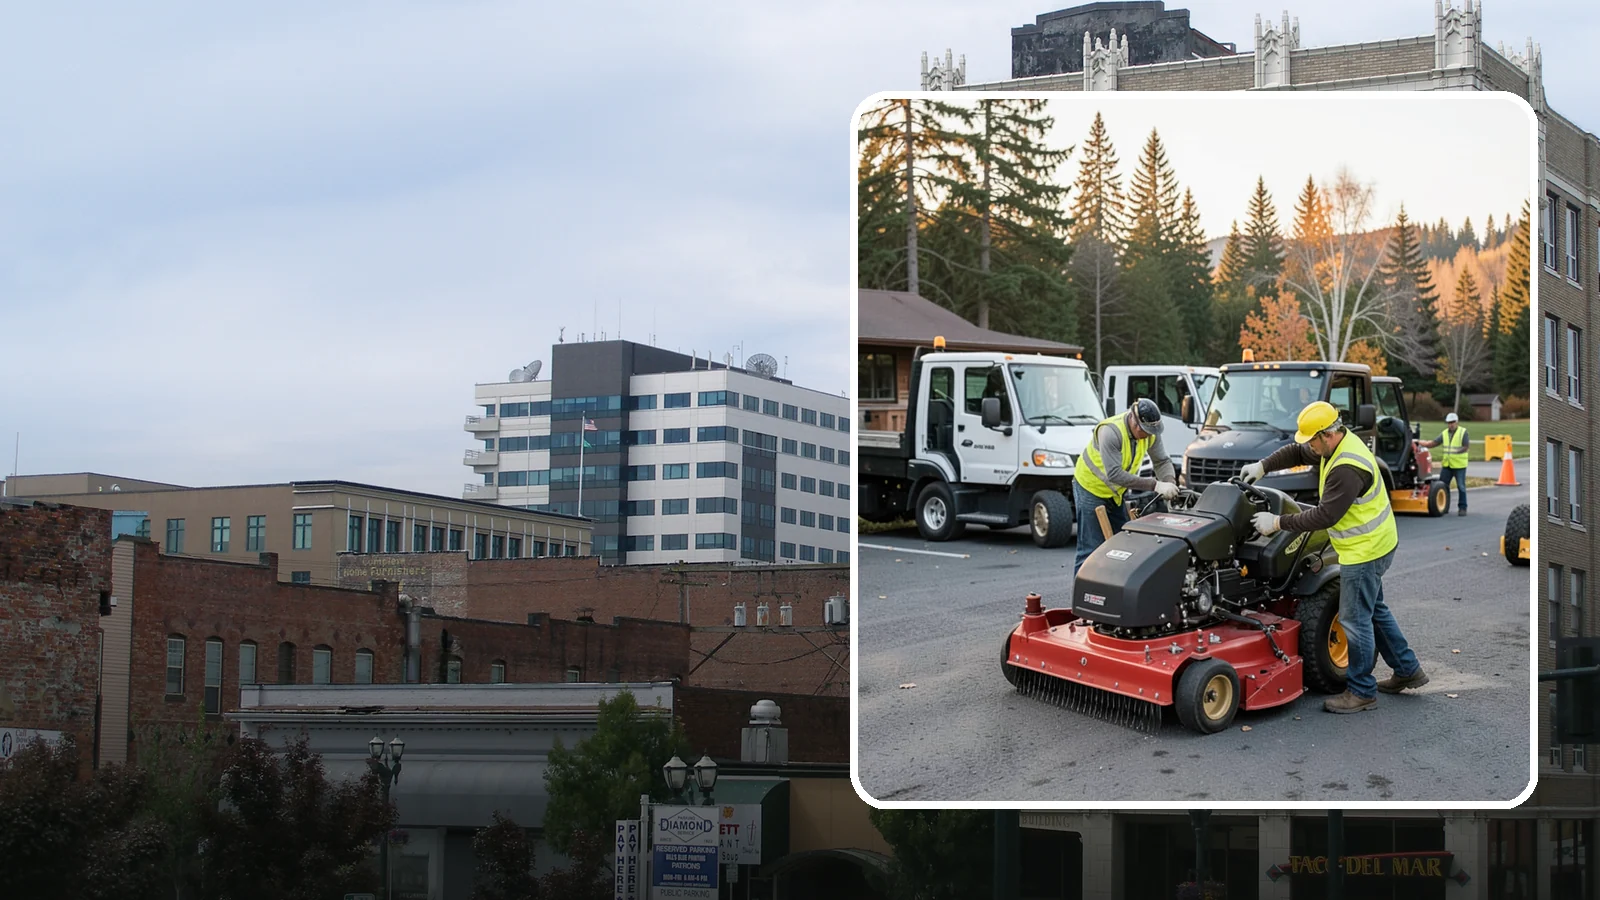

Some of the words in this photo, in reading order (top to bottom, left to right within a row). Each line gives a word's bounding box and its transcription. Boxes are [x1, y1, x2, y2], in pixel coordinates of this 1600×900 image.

[370, 566, 427, 576] Furnishers
[660, 818, 713, 833] DIAMOND
[1022, 815, 1070, 828] BUILDING
[656, 845, 688, 853] RESERVED
[689, 846, 716, 854] PARKING
[671, 862, 701, 870] PATRONS
[1346, 856, 1385, 875] DEL
[1392, 857, 1442, 876] MAR
[660, 888, 682, 897] PUBLIC
[683, 889, 710, 898] PARKING
